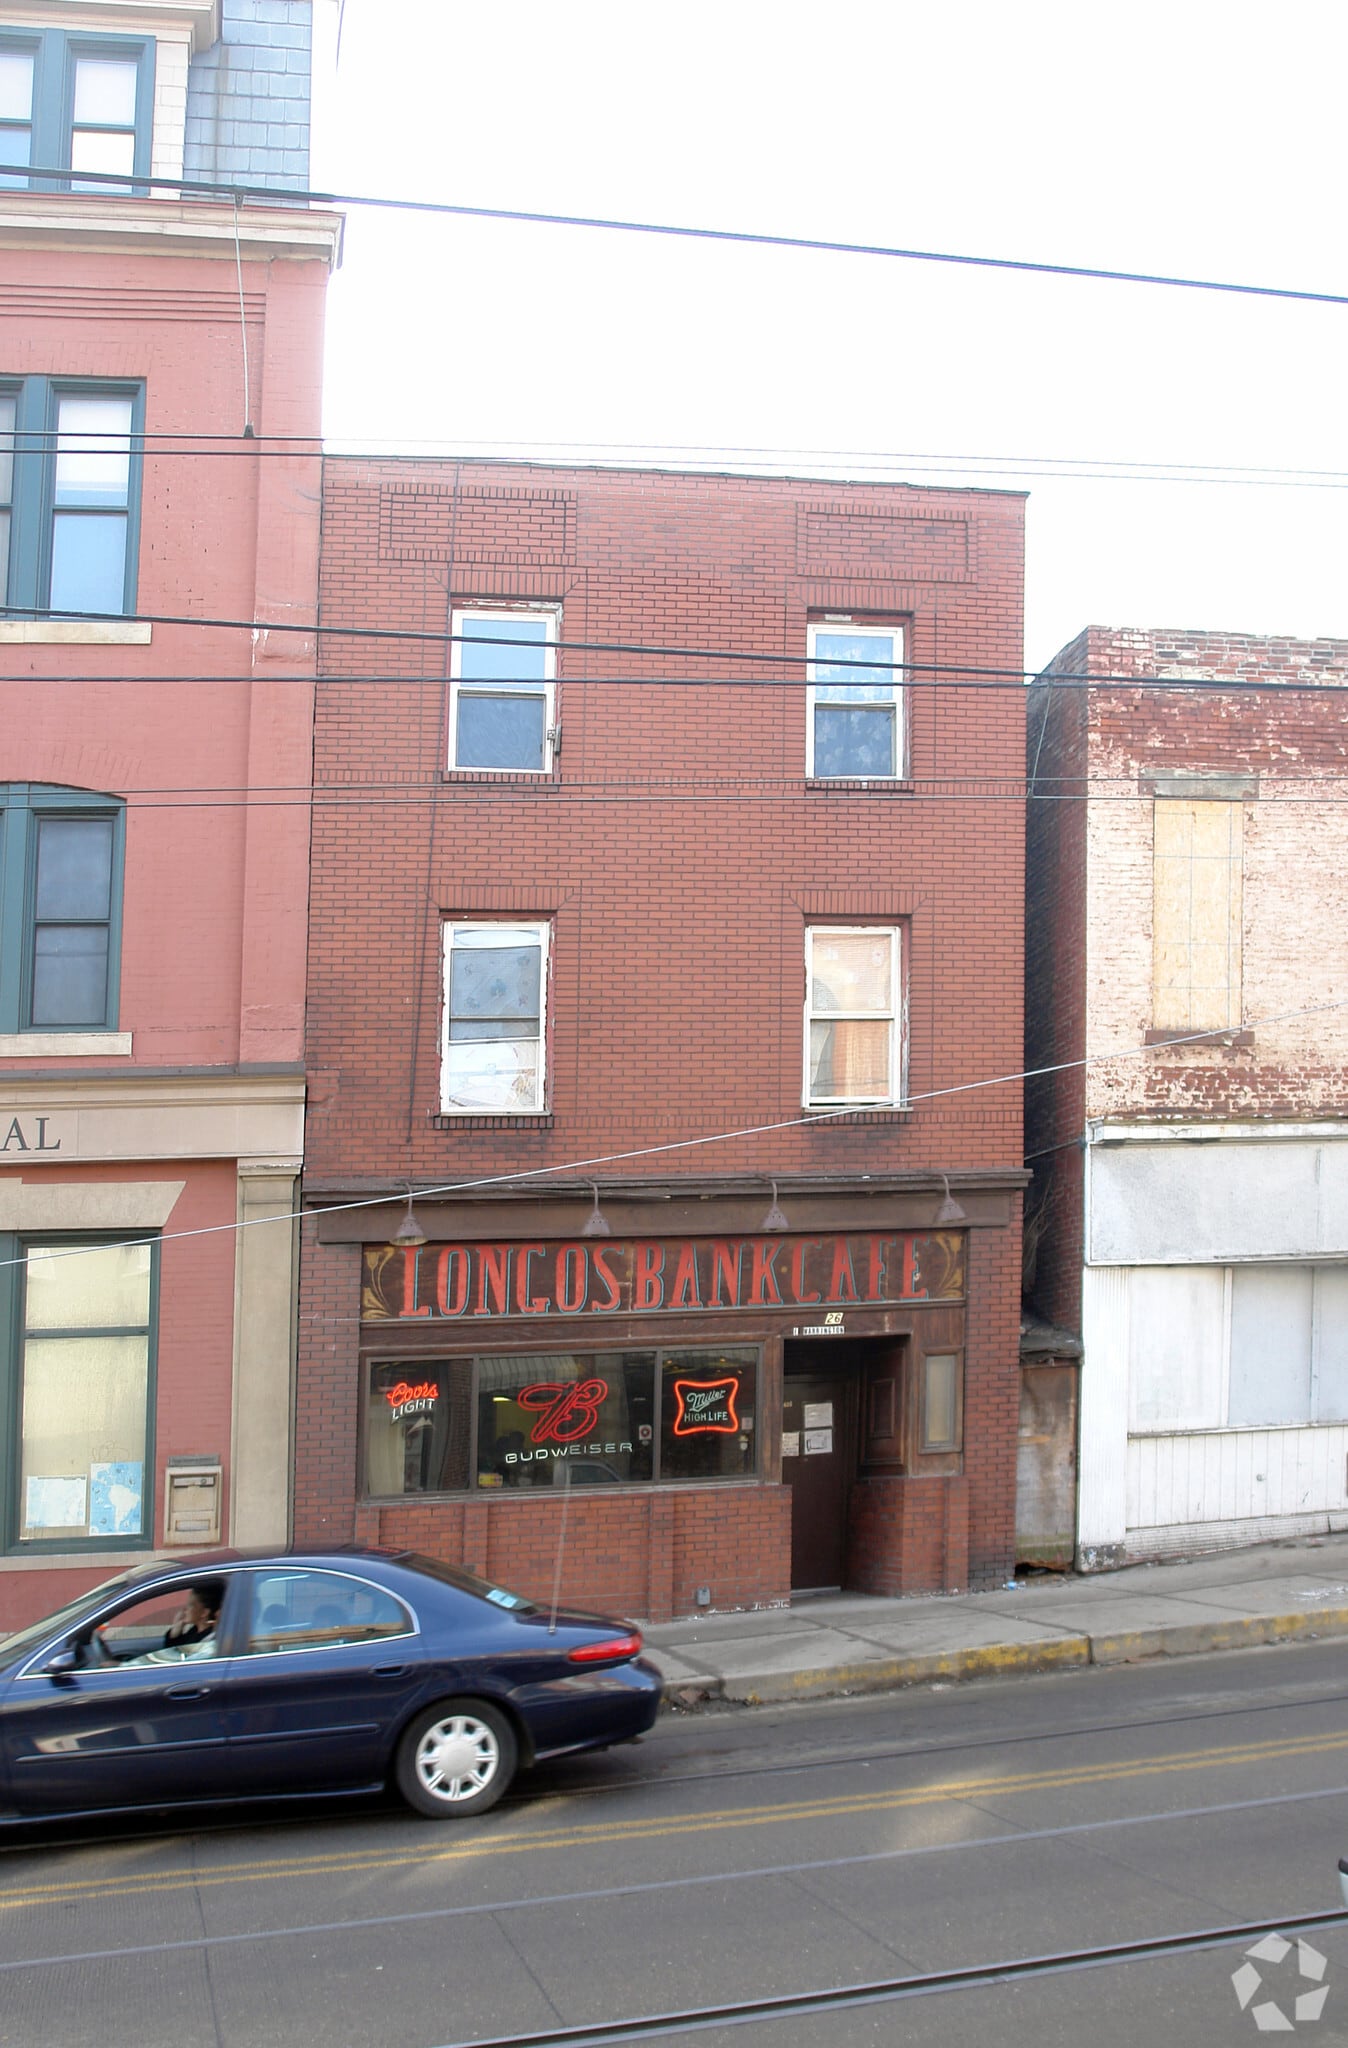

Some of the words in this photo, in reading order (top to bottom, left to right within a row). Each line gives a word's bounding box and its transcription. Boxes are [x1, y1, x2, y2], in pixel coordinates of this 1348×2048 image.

[0, 1116, 62, 1152] AL
[399, 1243, 625, 1320] LONGOS
[633, 1238, 784, 1313] BANK
[791, 1233, 931, 1306] CAFE
[827, 1312, 842, 1323] 26
[387, 1382, 439, 1407] Coors
[686, 1388, 727, 1413] Miller
[392, 1398, 436, 1420] LIGHT
[683, 1411, 707, 1423] HIGH
[707, 1410, 729, 1422] LIFE
[505, 1442, 633, 1464] BUDWEISER
